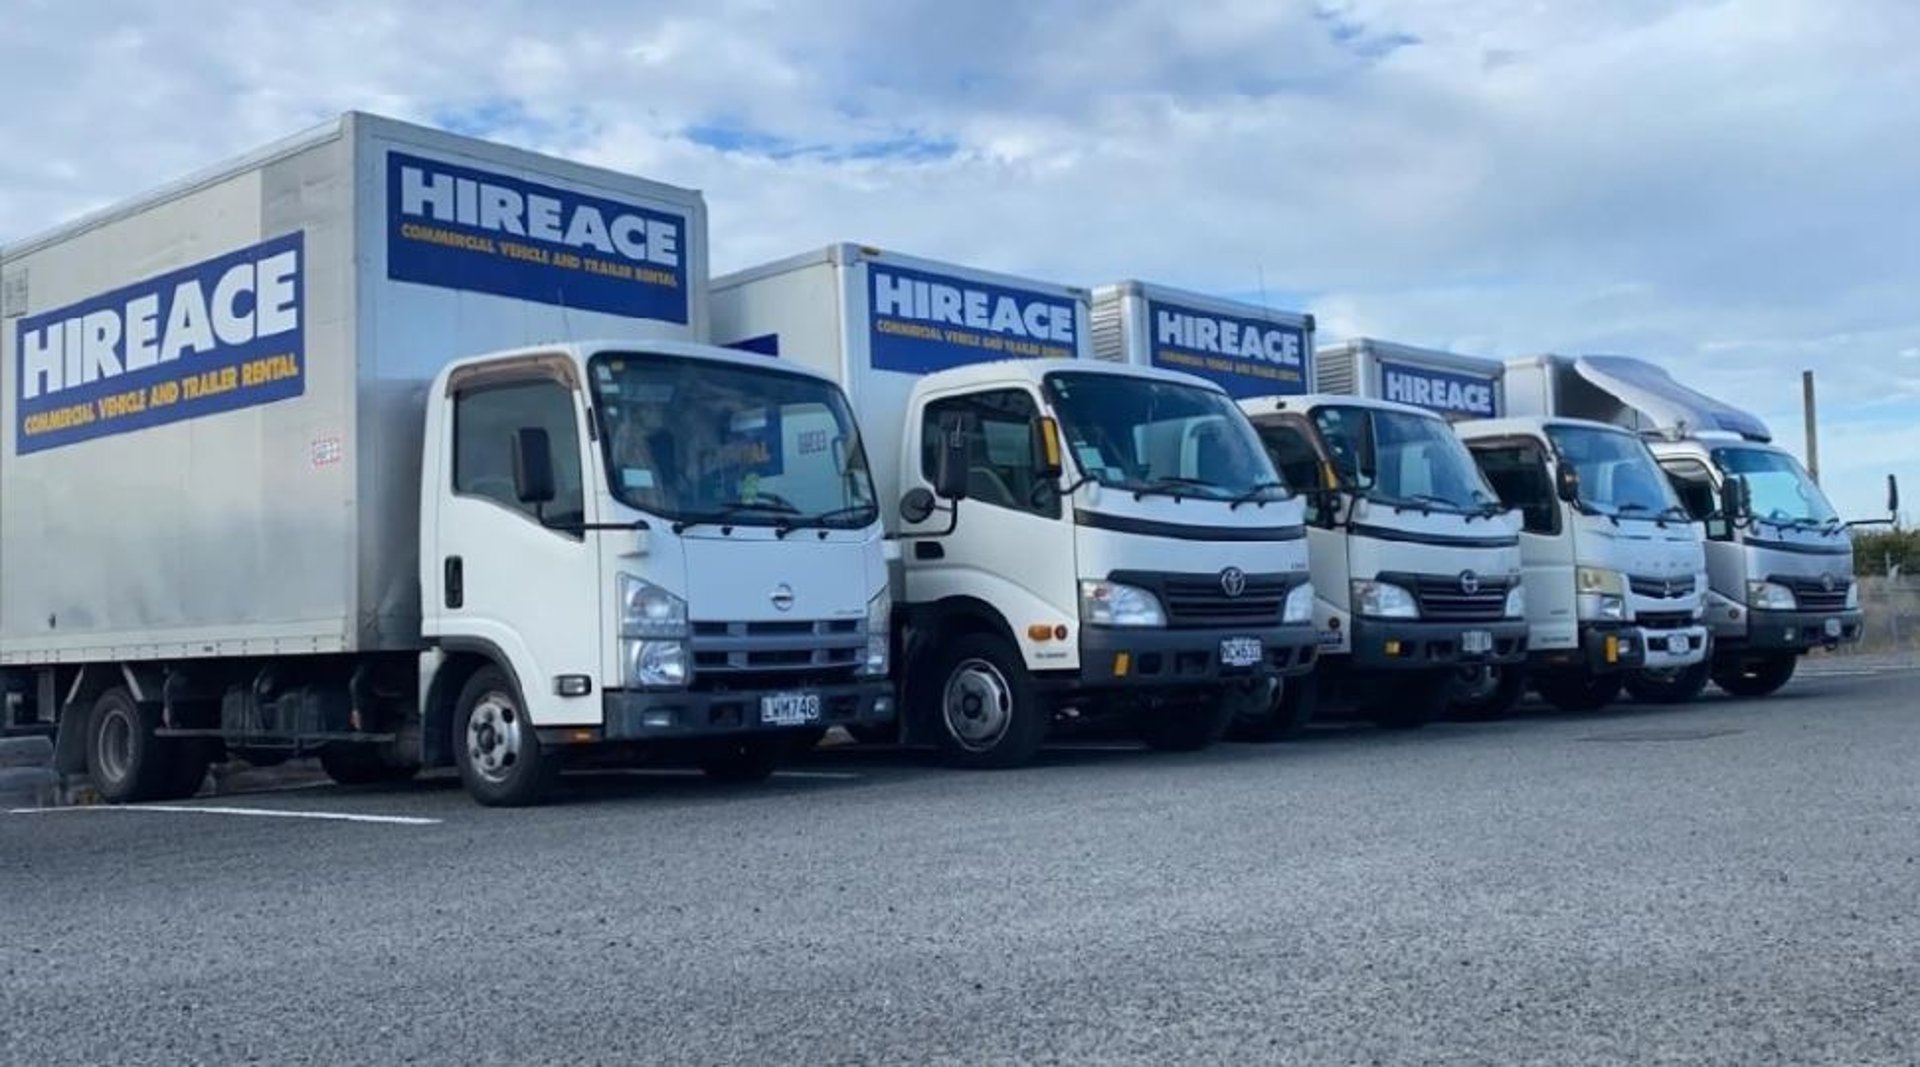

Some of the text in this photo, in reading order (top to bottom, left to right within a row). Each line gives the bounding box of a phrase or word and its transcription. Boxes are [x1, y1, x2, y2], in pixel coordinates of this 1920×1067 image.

[401, 165, 678, 266] HIREACE
[402, 223, 677, 287] COMMERCIAL VEHICLE AND TRAILER RENTAL
[24, 250, 298, 400] HIREACE
[875, 273, 1074, 343] HIREACE
[1158, 310, 1301, 366] HIREACE
[25, 353, 298, 435] COMMERCIAL VEHICLE AND TRAILER RENTAL
[1386, 371, 1492, 413] HIREACE
[762, 696, 819, 720] LWM748
